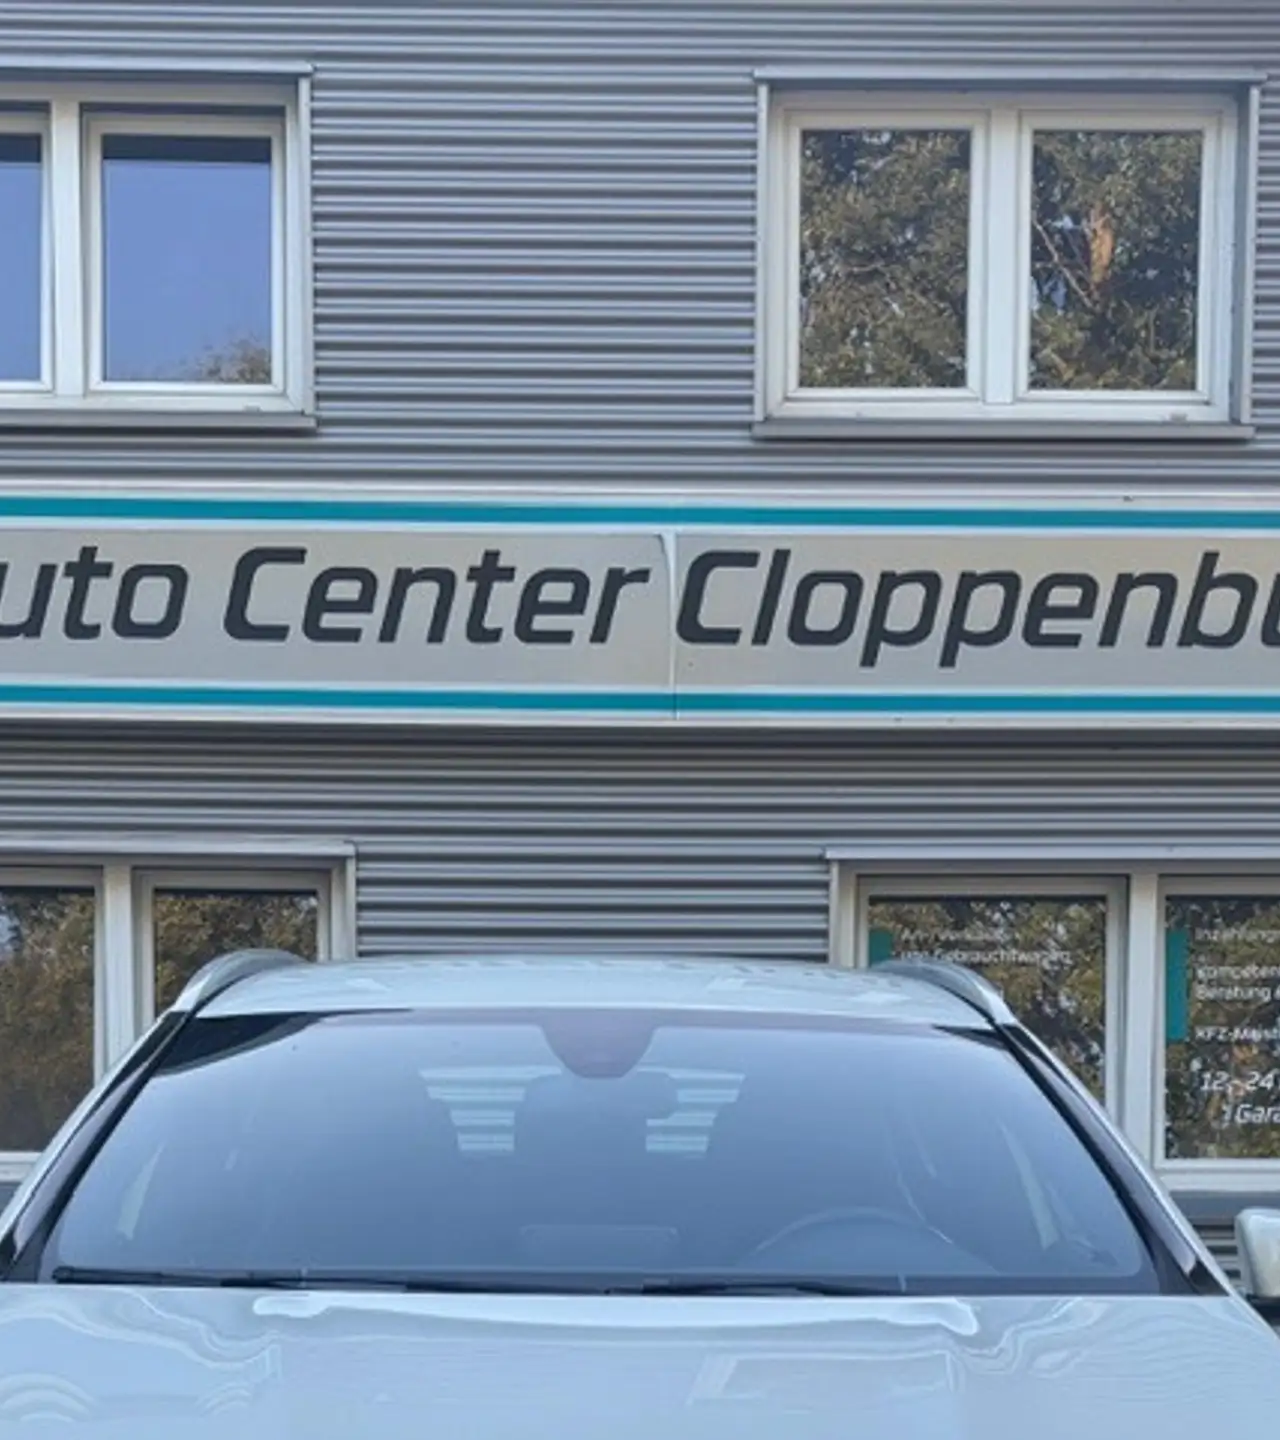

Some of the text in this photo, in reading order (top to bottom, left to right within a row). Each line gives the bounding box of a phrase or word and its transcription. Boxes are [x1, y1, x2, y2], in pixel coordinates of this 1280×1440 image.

[223, 546, 651, 645] Center
[1194, 984, 1270, 1001] Beratung
[1200, 1071, 1229, 1091] 12
[1246, 1071, 1274, 1091] 24
